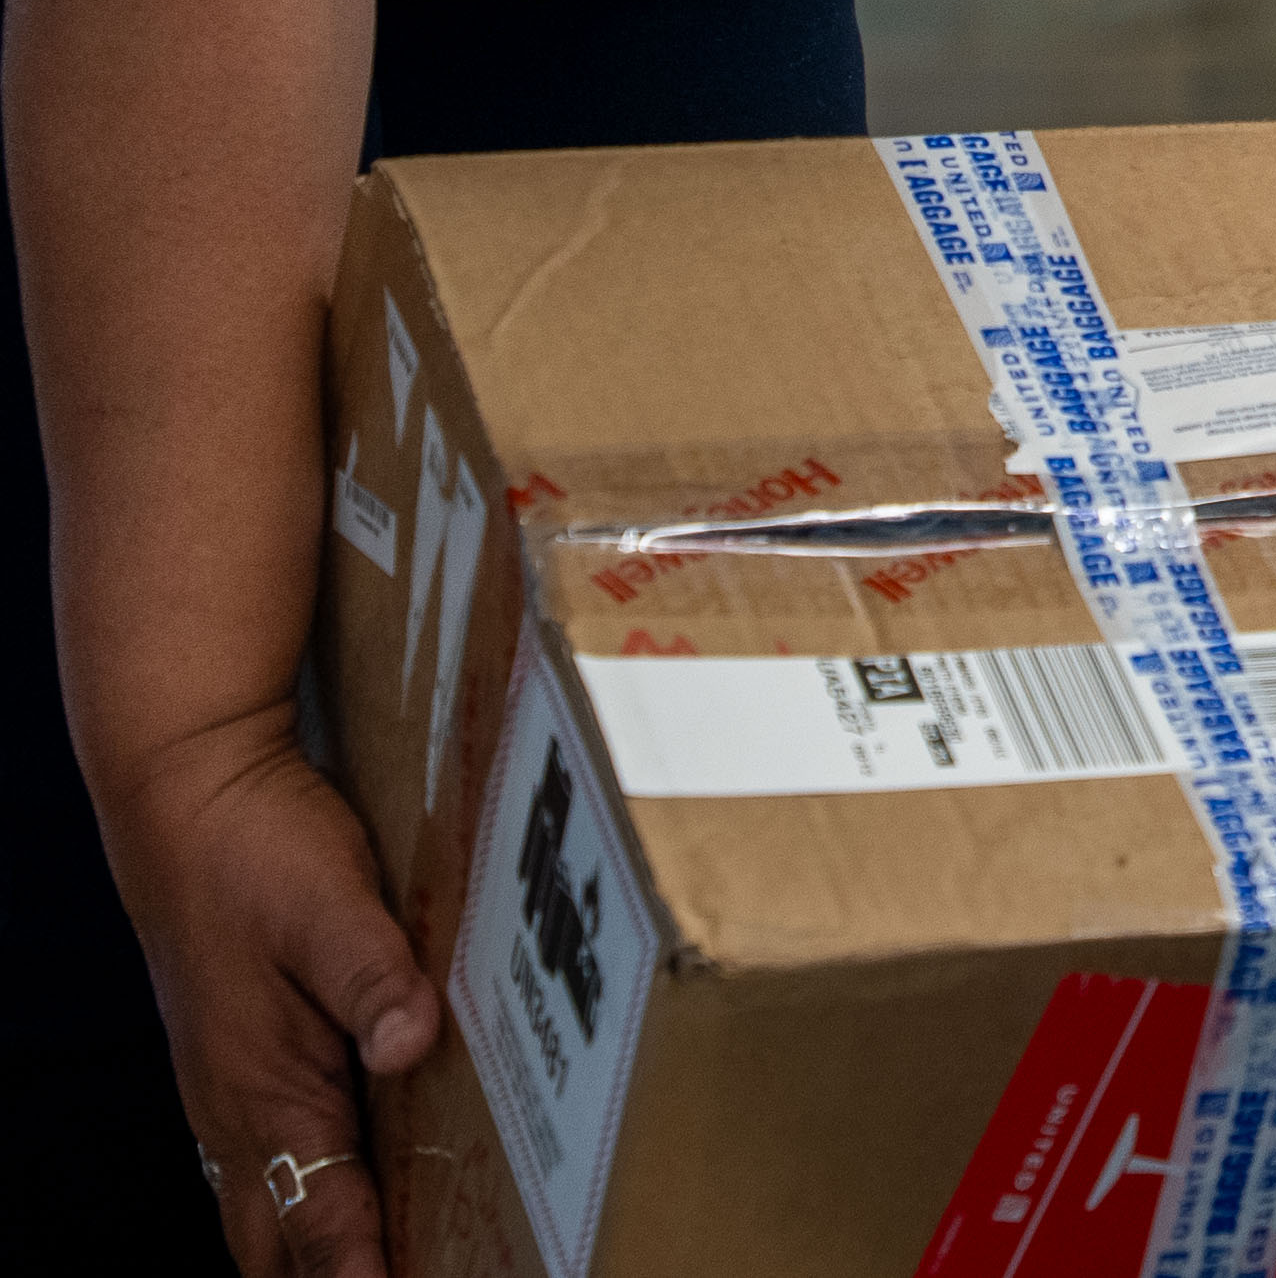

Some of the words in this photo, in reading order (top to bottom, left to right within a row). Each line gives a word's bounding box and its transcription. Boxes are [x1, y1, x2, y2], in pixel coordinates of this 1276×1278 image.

[940, 156, 995, 239] UNITED
[1044, 254, 1119, 361] BAGGAGE
[999, 351, 1055, 437] UNITED
[1022, 325, 1096, 434] BAGGAGE
[1099, 368, 1153, 455] UNITED
[1009, 1081, 1082, 1192] UNITED
